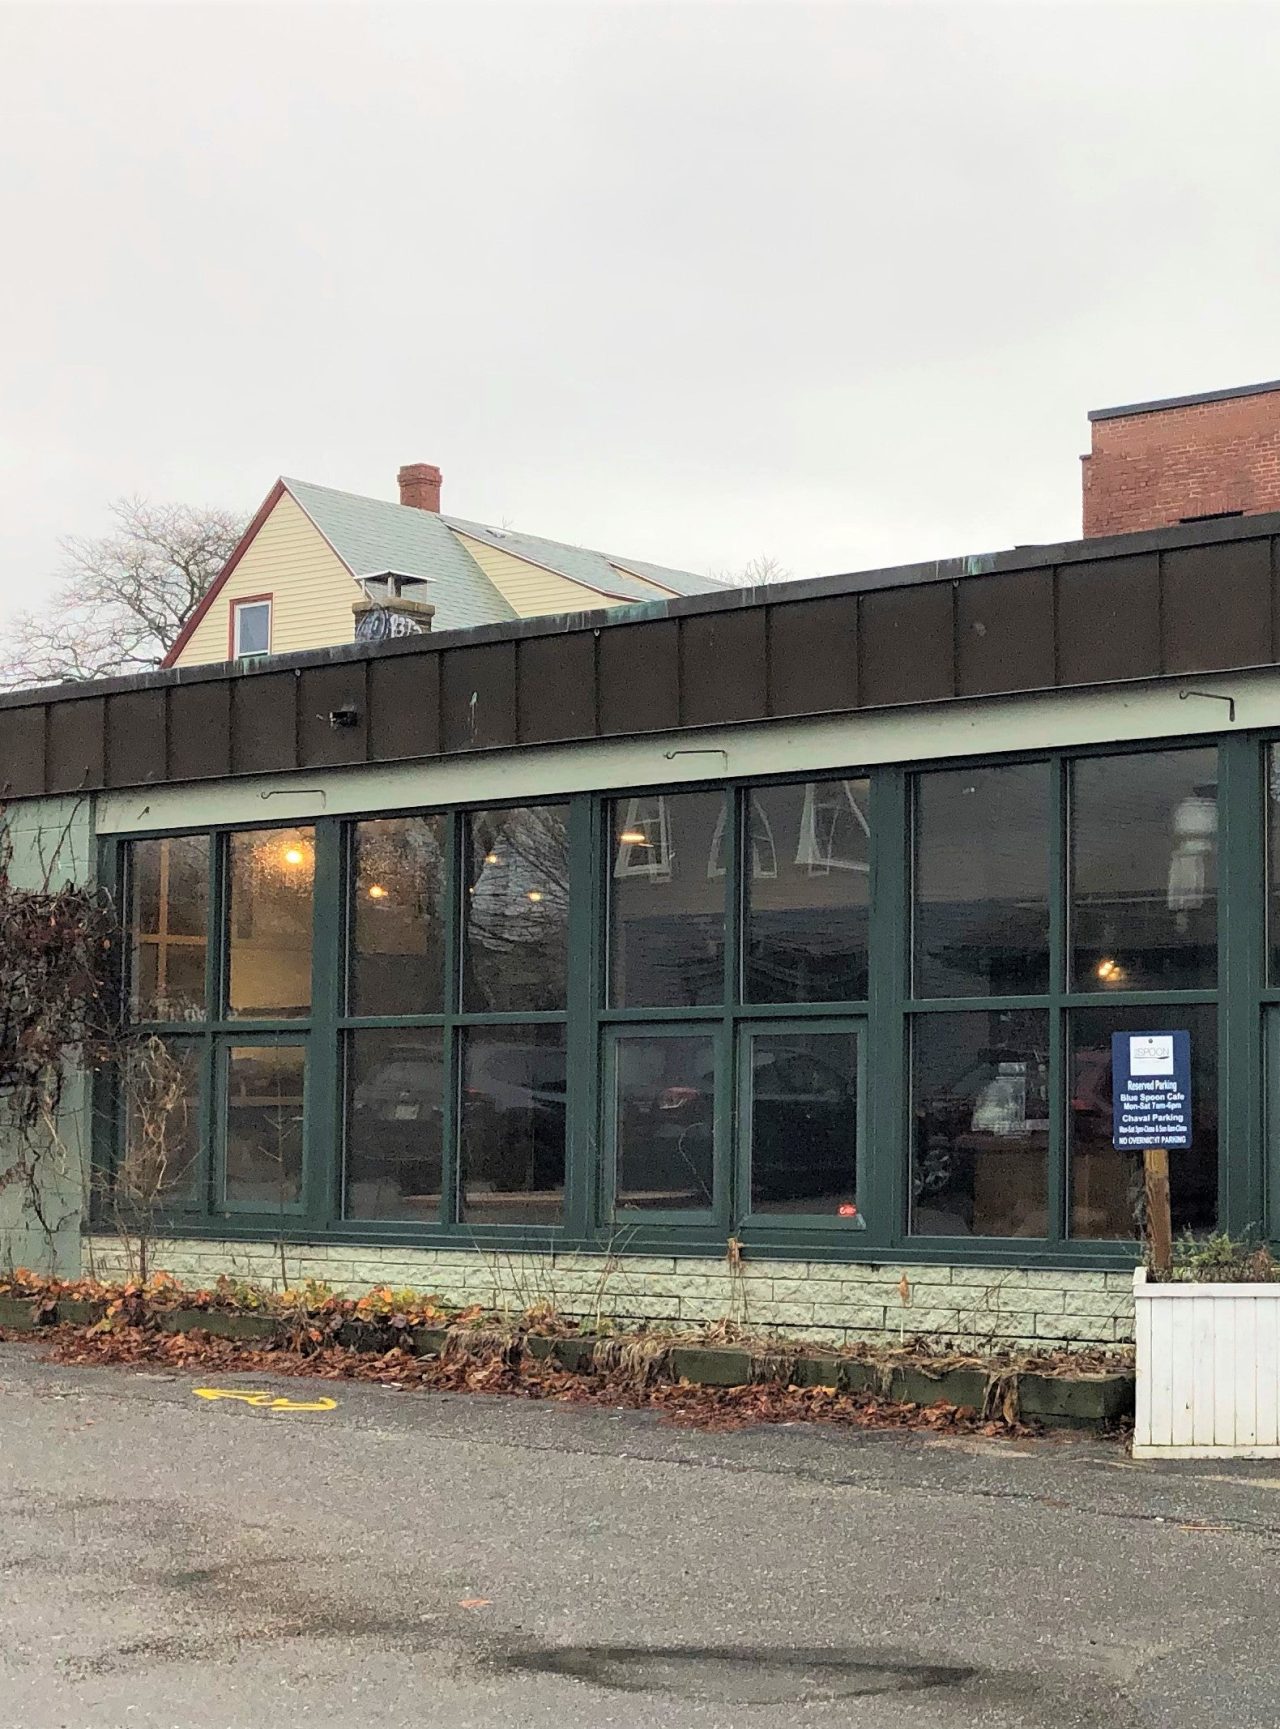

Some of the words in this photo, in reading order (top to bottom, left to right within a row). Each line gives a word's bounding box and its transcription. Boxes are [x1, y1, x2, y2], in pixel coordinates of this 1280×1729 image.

[1137, 1047, 1169, 1056] SPOON
[1128, 1080, 1154, 1090] Reserved
[1155, 1079, 1177, 1092] Parking
[1140, 1093, 1165, 1102] Spoon
[1124, 1102, 1150, 1110] Mon-Sat
[1152, 1113, 1184, 1123] Parking
[1161, 1135, 1187, 1144] PARKING
